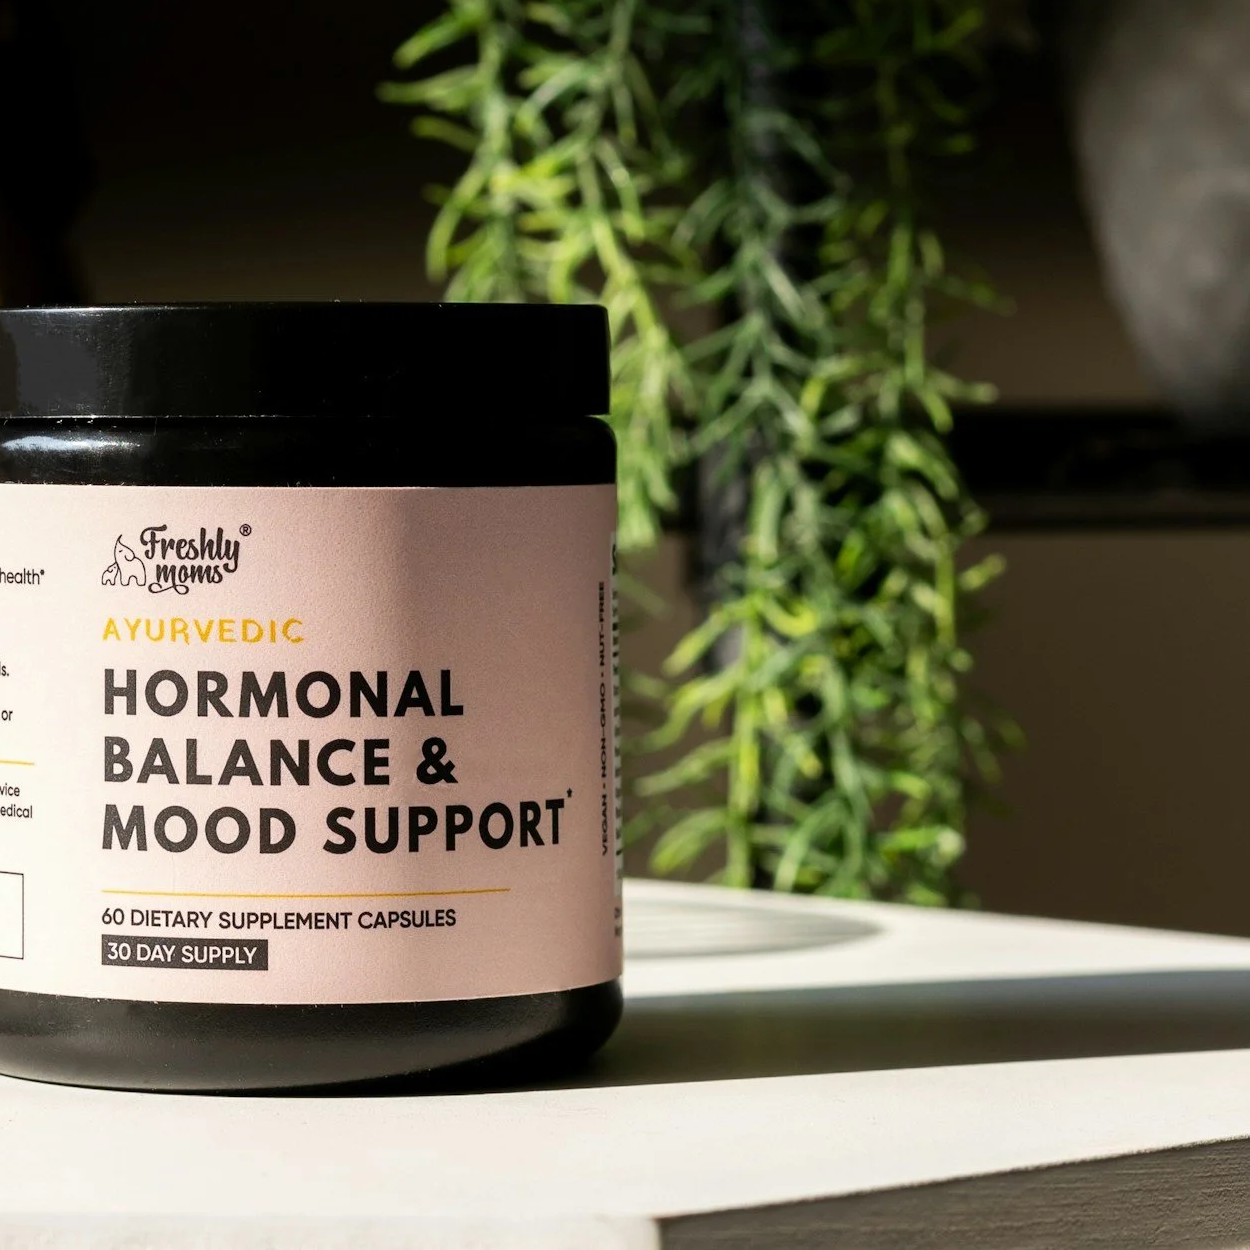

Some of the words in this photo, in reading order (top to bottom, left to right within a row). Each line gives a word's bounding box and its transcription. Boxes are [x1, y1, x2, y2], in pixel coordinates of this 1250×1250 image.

[147, 564, 224, 596] moms
[102, 617, 305, 645] AYURVEDIC
[104, 665, 465, 719] HORMONAL
[1, 709, 14, 722] or
[104, 736, 391, 787] BALANCE
[416, 736, 459, 785] &
[102, 803, 297, 855] MOOD
[601, 794, 609, 857] VEGAN
[101, 907, 125, 926] 60
[130, 909, 213, 929] DIETARY
[218, 911, 353, 930] SUPPLEMENT
[357, 908, 457, 930] CAPSULES
[107, 941, 132, 961] 30
[136, 943, 176, 963] DAY
[181, 945, 258, 965] SUPPLY
